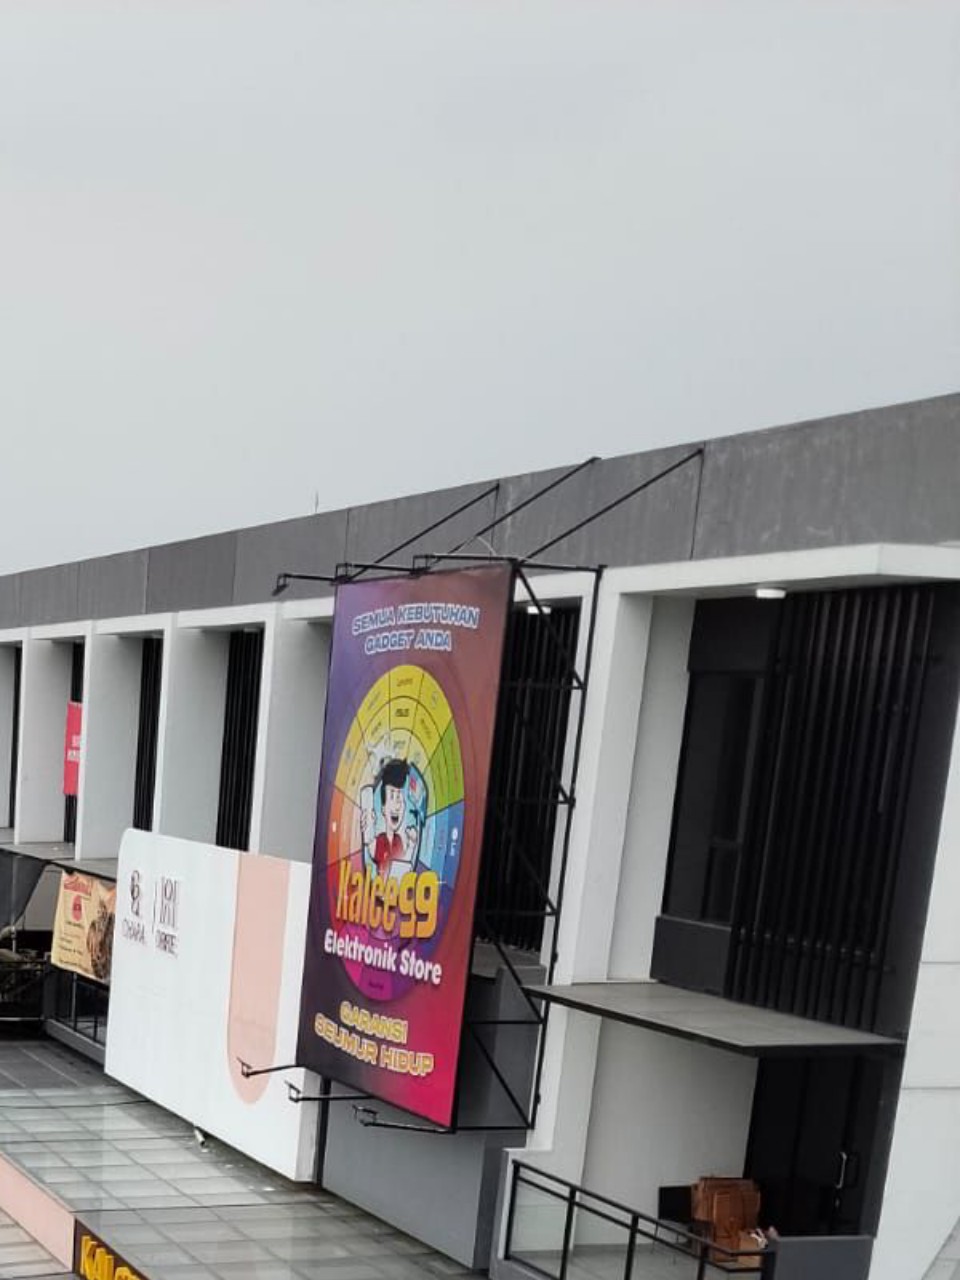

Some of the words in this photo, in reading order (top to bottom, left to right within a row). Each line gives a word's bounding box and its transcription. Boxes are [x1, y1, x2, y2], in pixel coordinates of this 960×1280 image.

[352, 606, 395, 635] SEMUA
[398, 602, 479, 629] KEBUTUHAN
[365, 631, 414, 654] GADGET
[416, 629, 451, 651] ANDA
[324, 928, 397, 972] Elektronik
[399, 948, 442, 985] Store
[340, 1001, 408, 1044] GARANSI
[314, 1012, 378, 1065] SEUMUR
[380, 1042, 434, 1077] HIDUP
